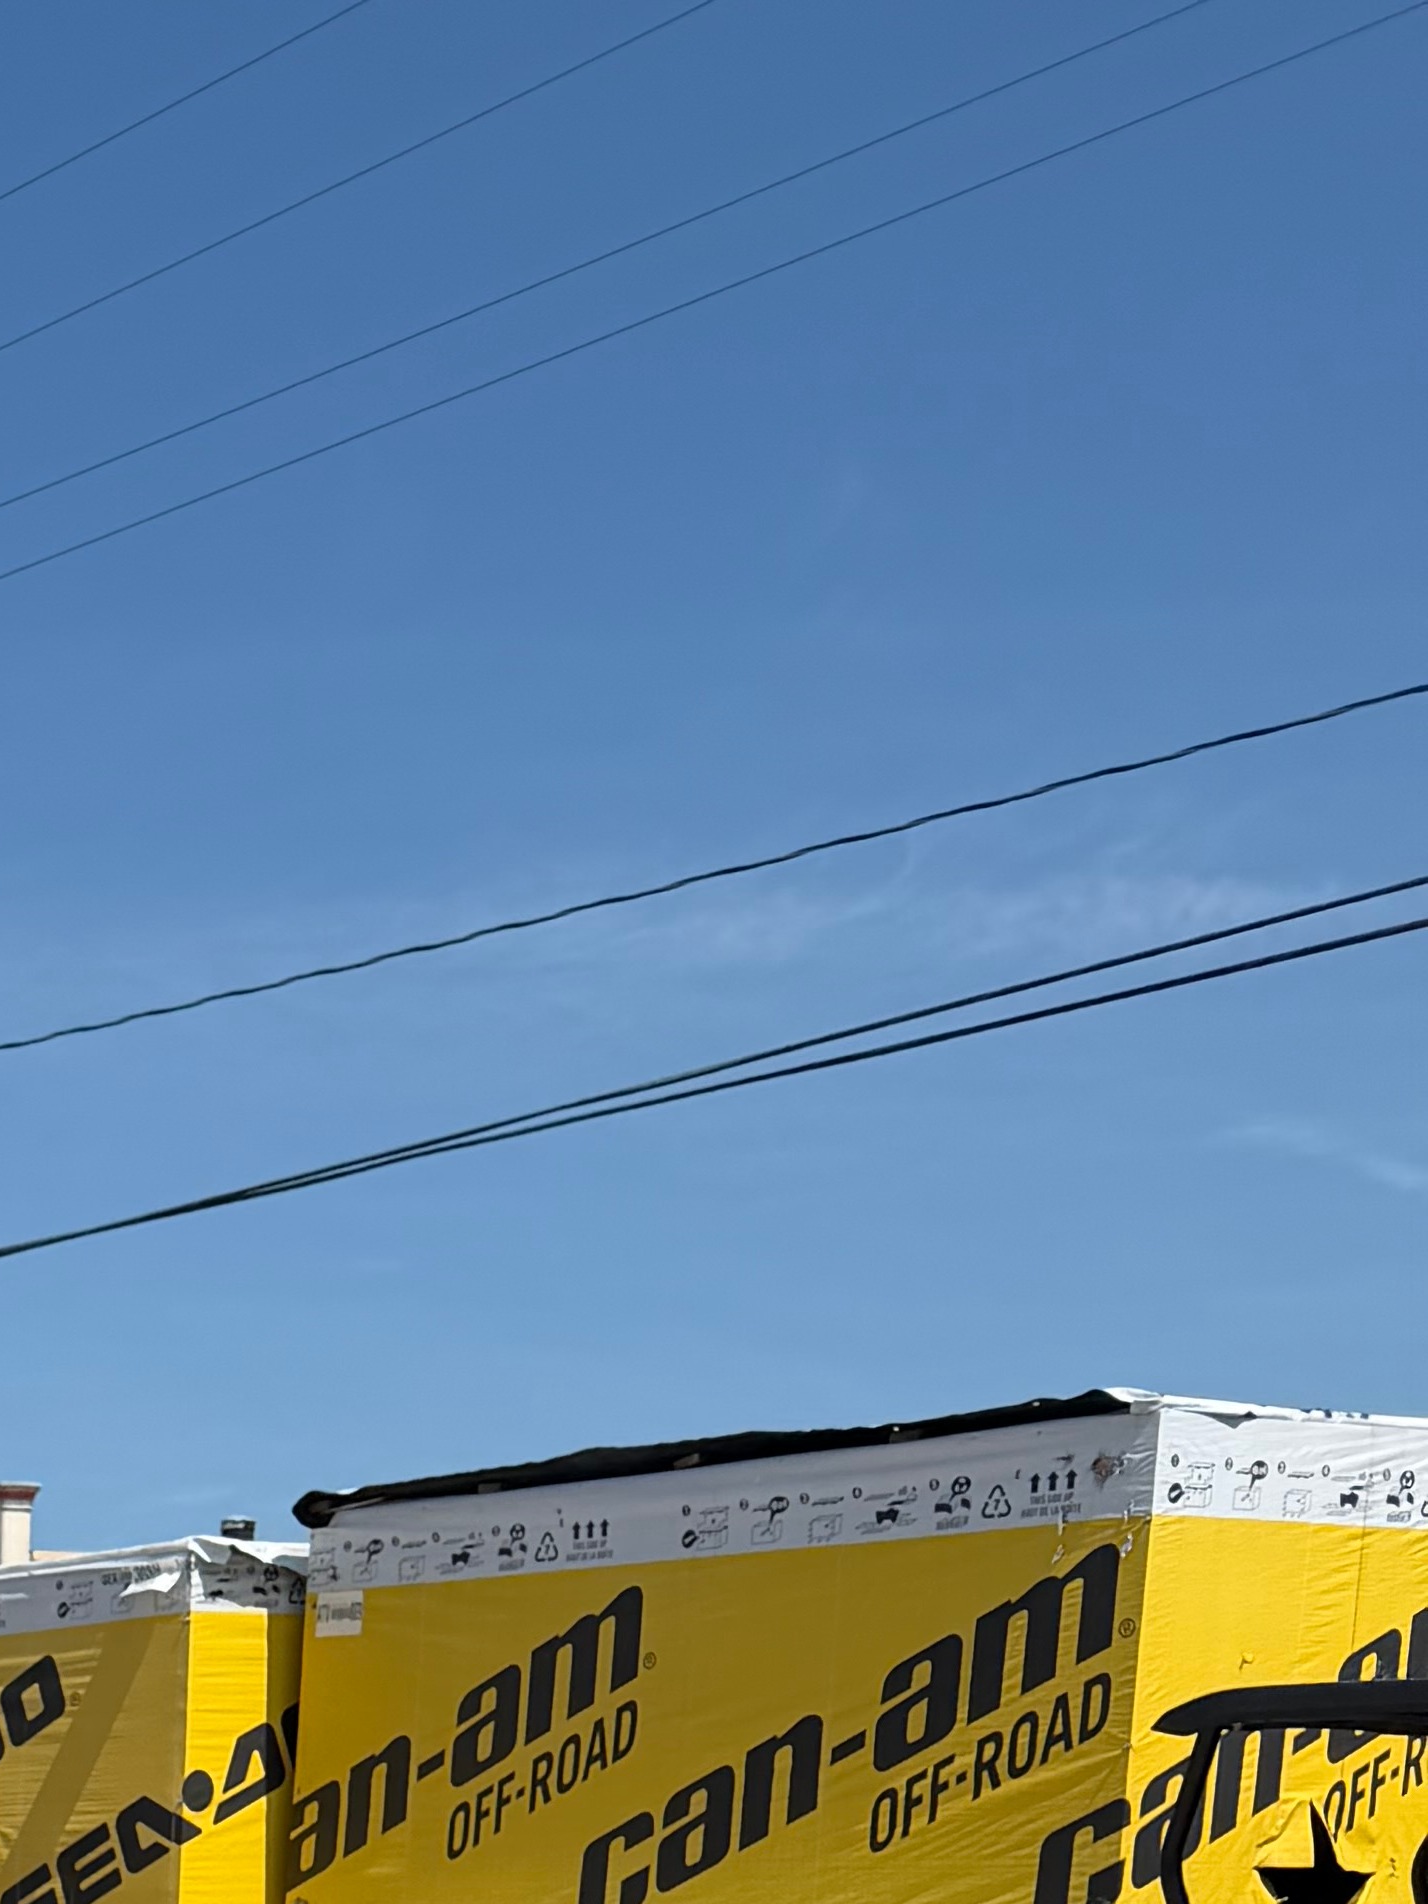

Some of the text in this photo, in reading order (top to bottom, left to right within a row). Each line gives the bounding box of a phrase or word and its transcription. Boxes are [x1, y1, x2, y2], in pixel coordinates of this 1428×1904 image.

[285, 1585, 644, 1892] an-am
[447, 1699, 639, 1860] OFF-ROAD
[869, 1672, 1112, 1853] OFF-ROAD
